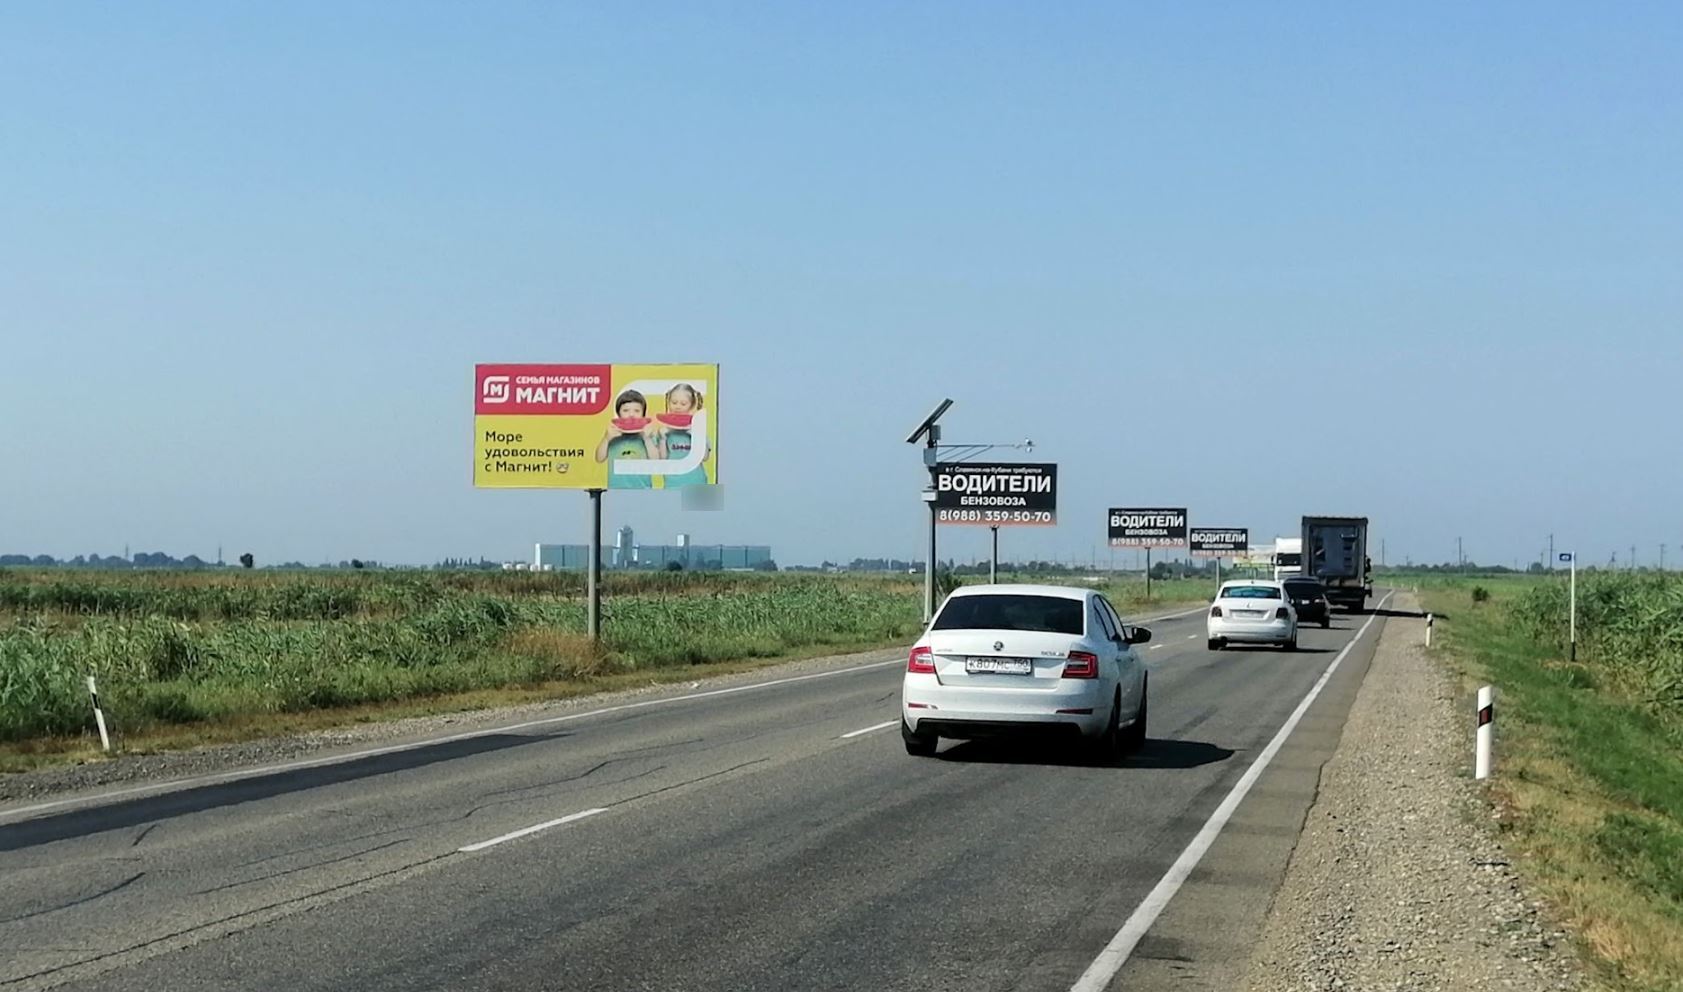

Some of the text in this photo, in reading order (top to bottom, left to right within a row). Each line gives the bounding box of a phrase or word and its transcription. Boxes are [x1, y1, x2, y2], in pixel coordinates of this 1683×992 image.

[516, 376, 600, 385] СЕМЬЯ МАГАЗИНОВ
[516, 387, 600, 404] МАГНИТ
[485, 431, 523, 445] Море
[485, 448, 585, 460] удовольствия
[485, 461, 552, 472] с Магнит!
[938, 474, 1051, 495] ВОДИТЕЛИ
[960, 496, 1027, 506] БЕНЗОВОЗА
[940, 509, 1051, 522] 8(988) 359-50-70
[1110, 515, 1184, 529] ВОДИТЕЛИ
[1191, 533, 1246, 544] ВОДИТЕЛИ
